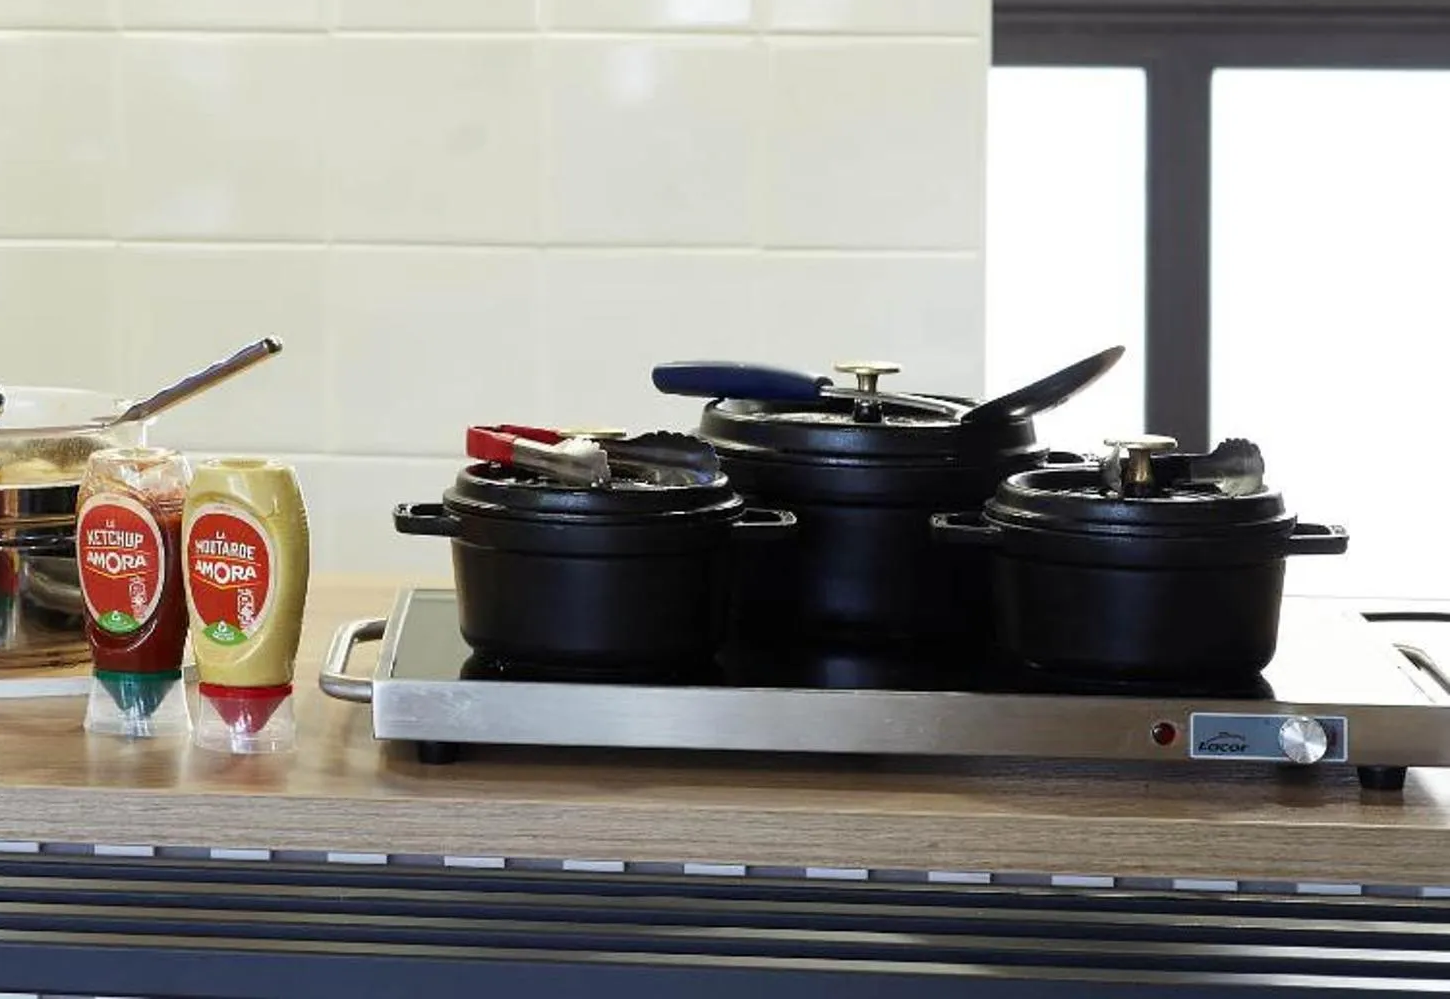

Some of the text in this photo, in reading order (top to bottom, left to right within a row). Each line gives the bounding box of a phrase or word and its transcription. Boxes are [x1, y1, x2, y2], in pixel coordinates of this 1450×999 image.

[87, 529, 144, 550] KETCHUP
[195, 539, 257, 561] MOUTARDE
[86, 551, 148, 574] AMORA
[195, 559, 258, 584] AMORA
